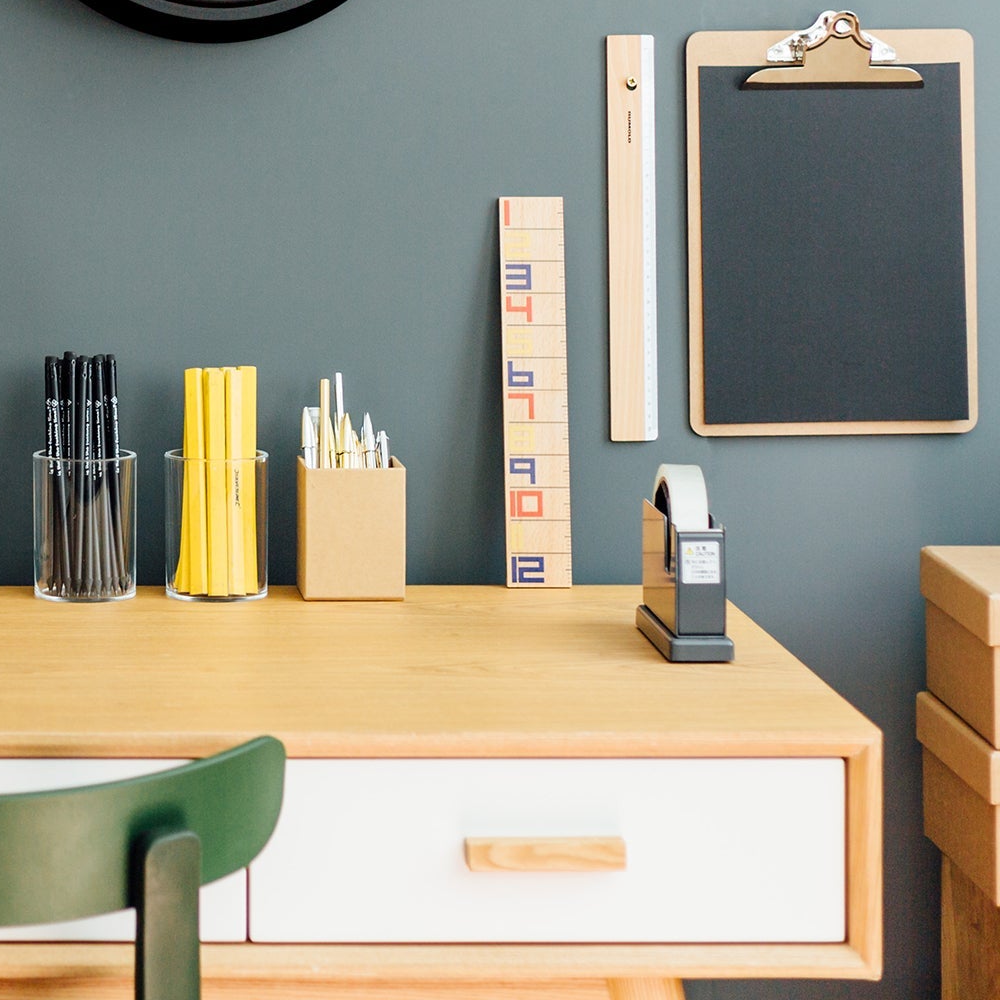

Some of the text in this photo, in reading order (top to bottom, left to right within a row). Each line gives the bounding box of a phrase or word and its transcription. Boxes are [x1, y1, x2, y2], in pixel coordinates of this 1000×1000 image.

[505, 264, 532, 290] 3
[506, 296, 532, 322] 4
[508, 393, 534, 419] 7
[510, 458, 536, 484] 9
[510, 491, 543, 517] 10
[511, 556, 545, 583] 12
